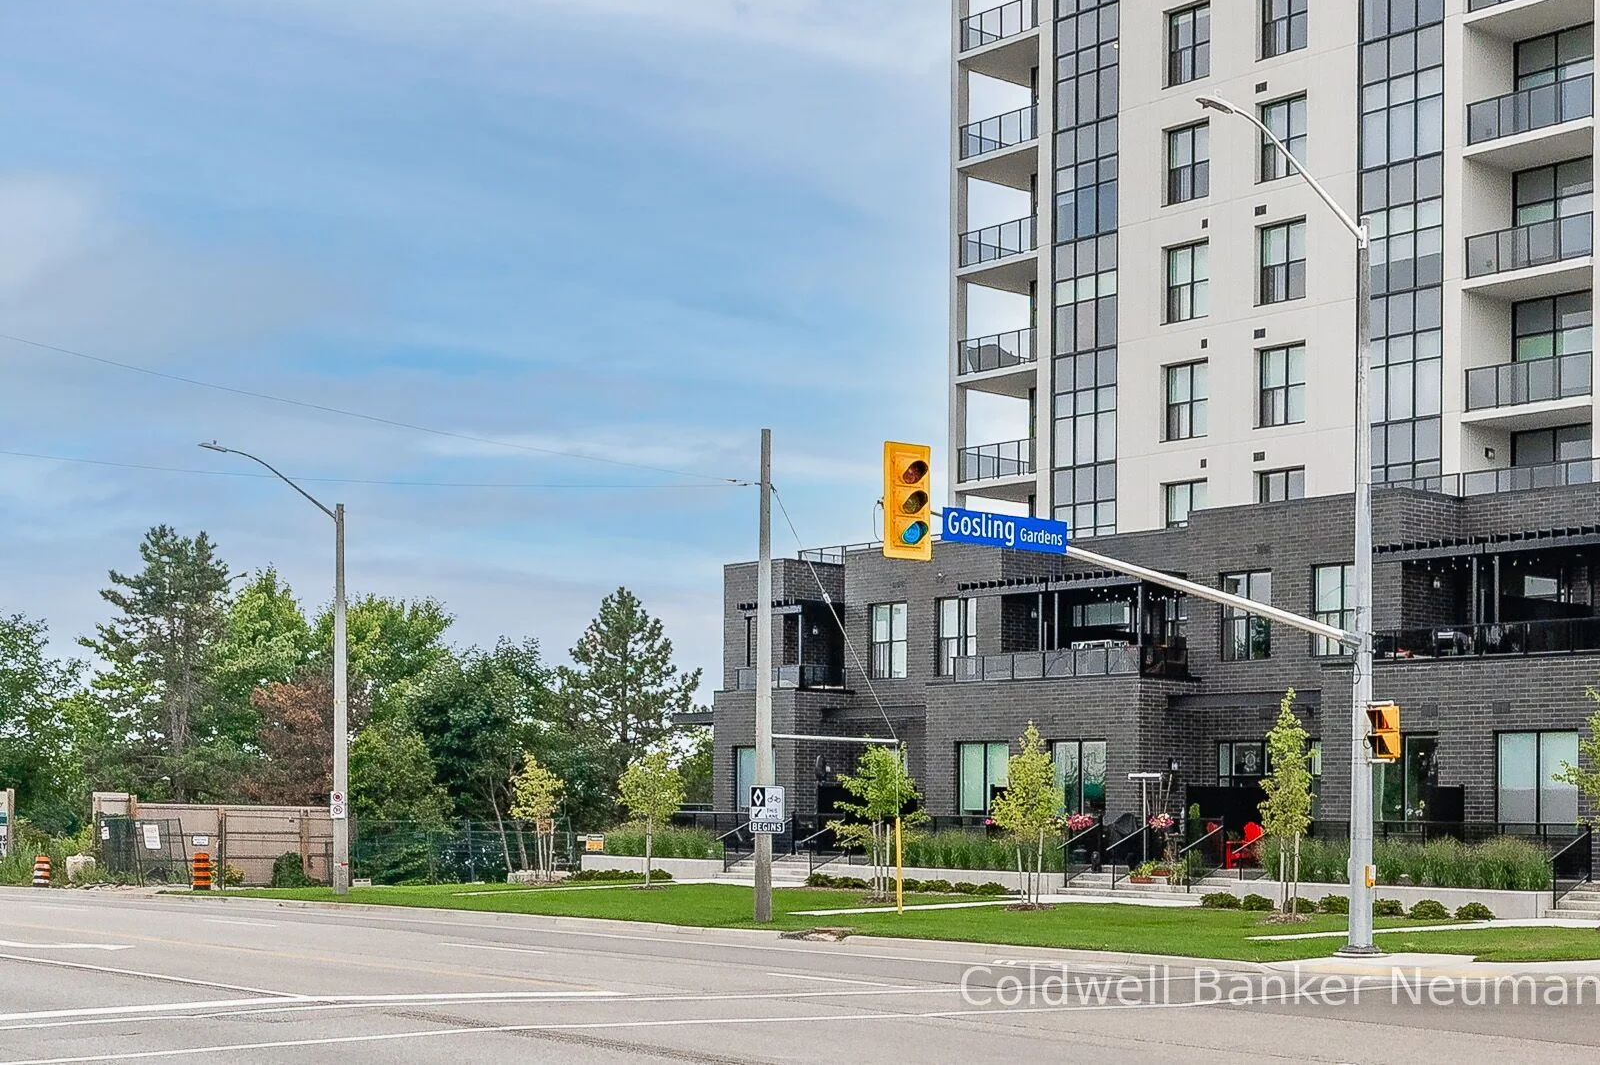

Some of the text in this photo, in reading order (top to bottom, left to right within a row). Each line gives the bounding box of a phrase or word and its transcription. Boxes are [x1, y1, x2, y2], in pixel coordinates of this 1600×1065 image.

[948, 511, 1063, 546] Gosling Gardens
[752, 822, 782, 832] BEGINS
